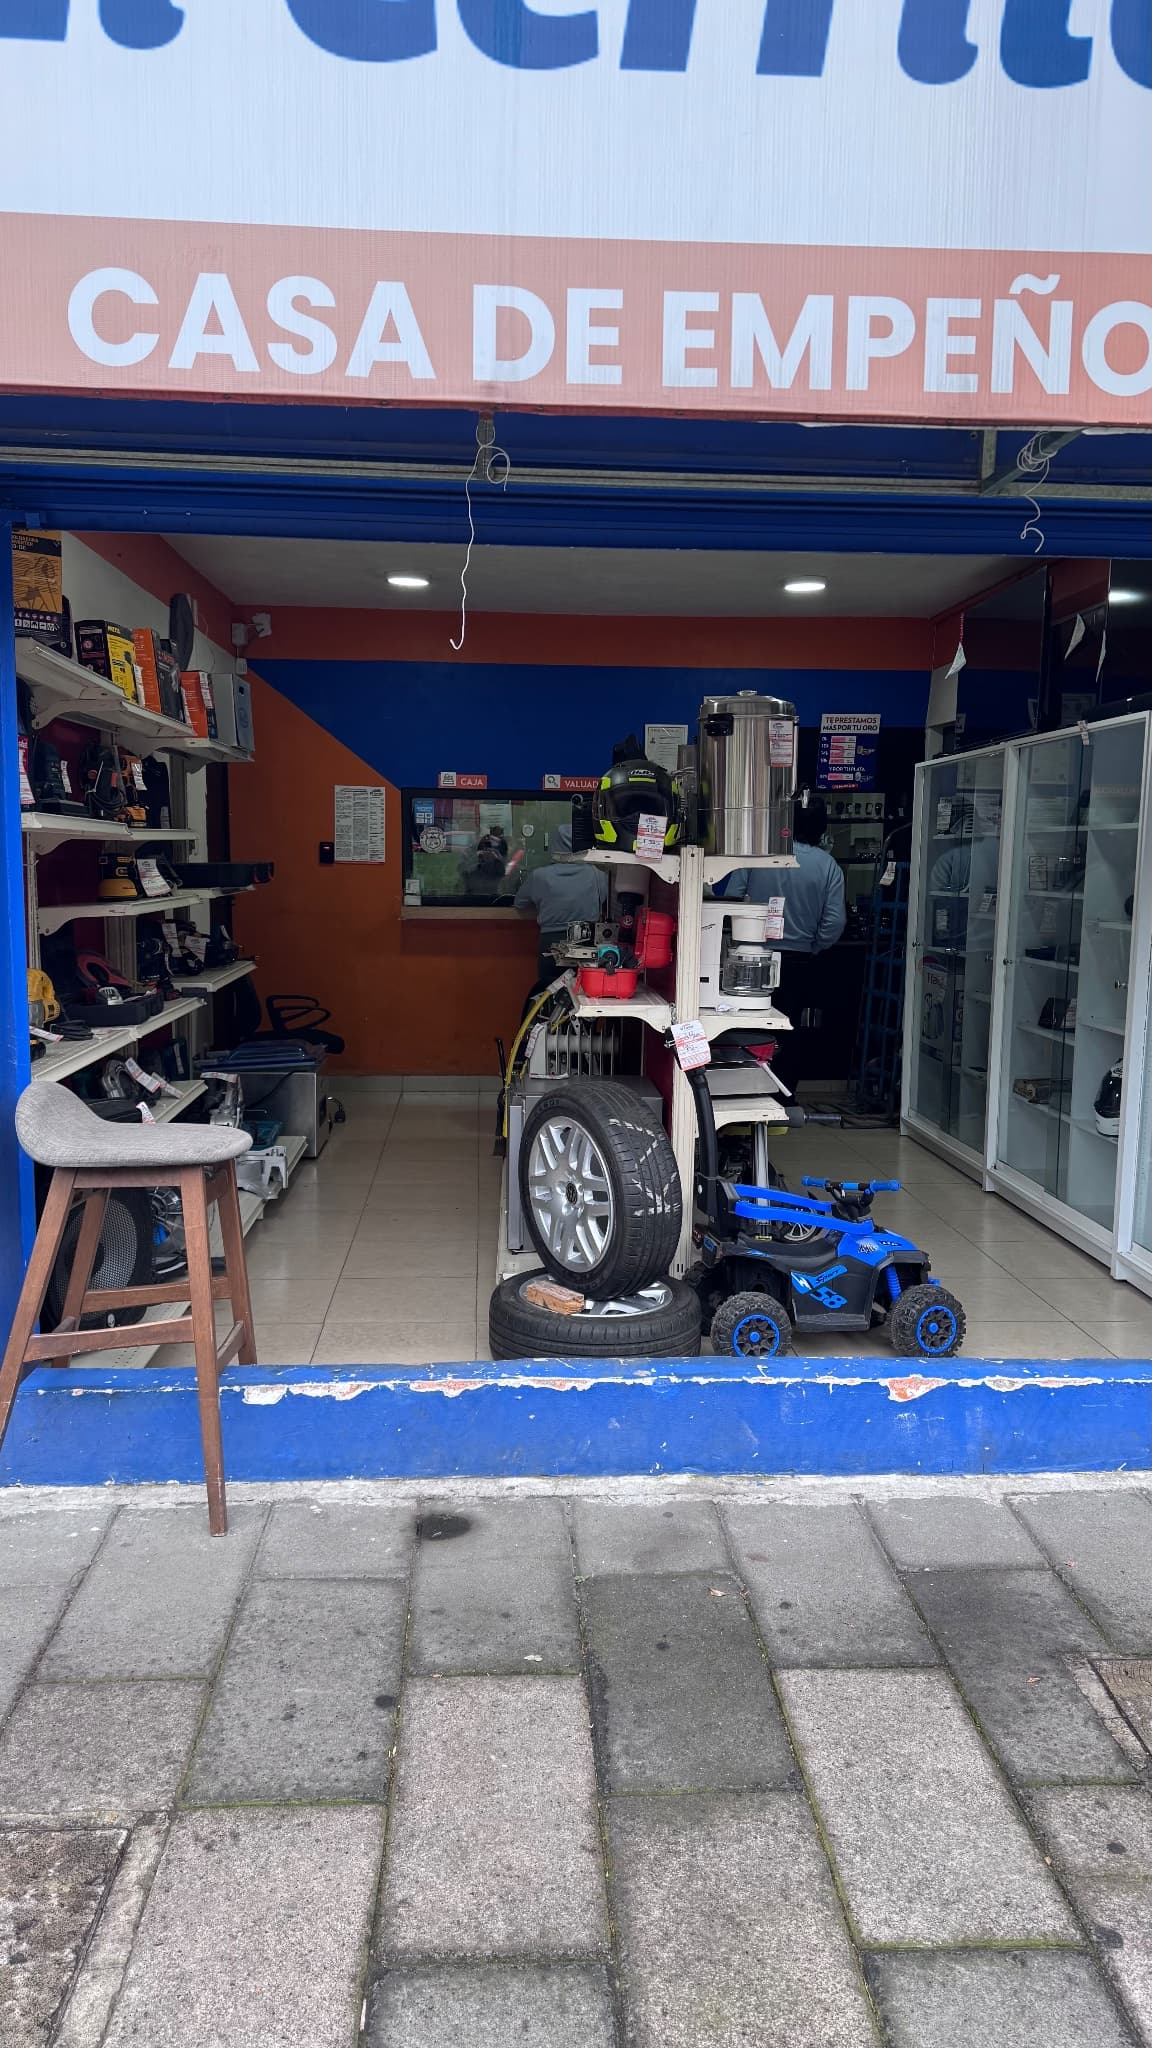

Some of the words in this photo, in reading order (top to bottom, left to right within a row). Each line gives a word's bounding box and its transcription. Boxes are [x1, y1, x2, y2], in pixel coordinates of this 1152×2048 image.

[67, 266, 437, 380] CASA
[472, 283, 624, 386] DE
[661, 272, 1152, 397] EMPEÑO
[460, 777, 484, 786] CAJA
